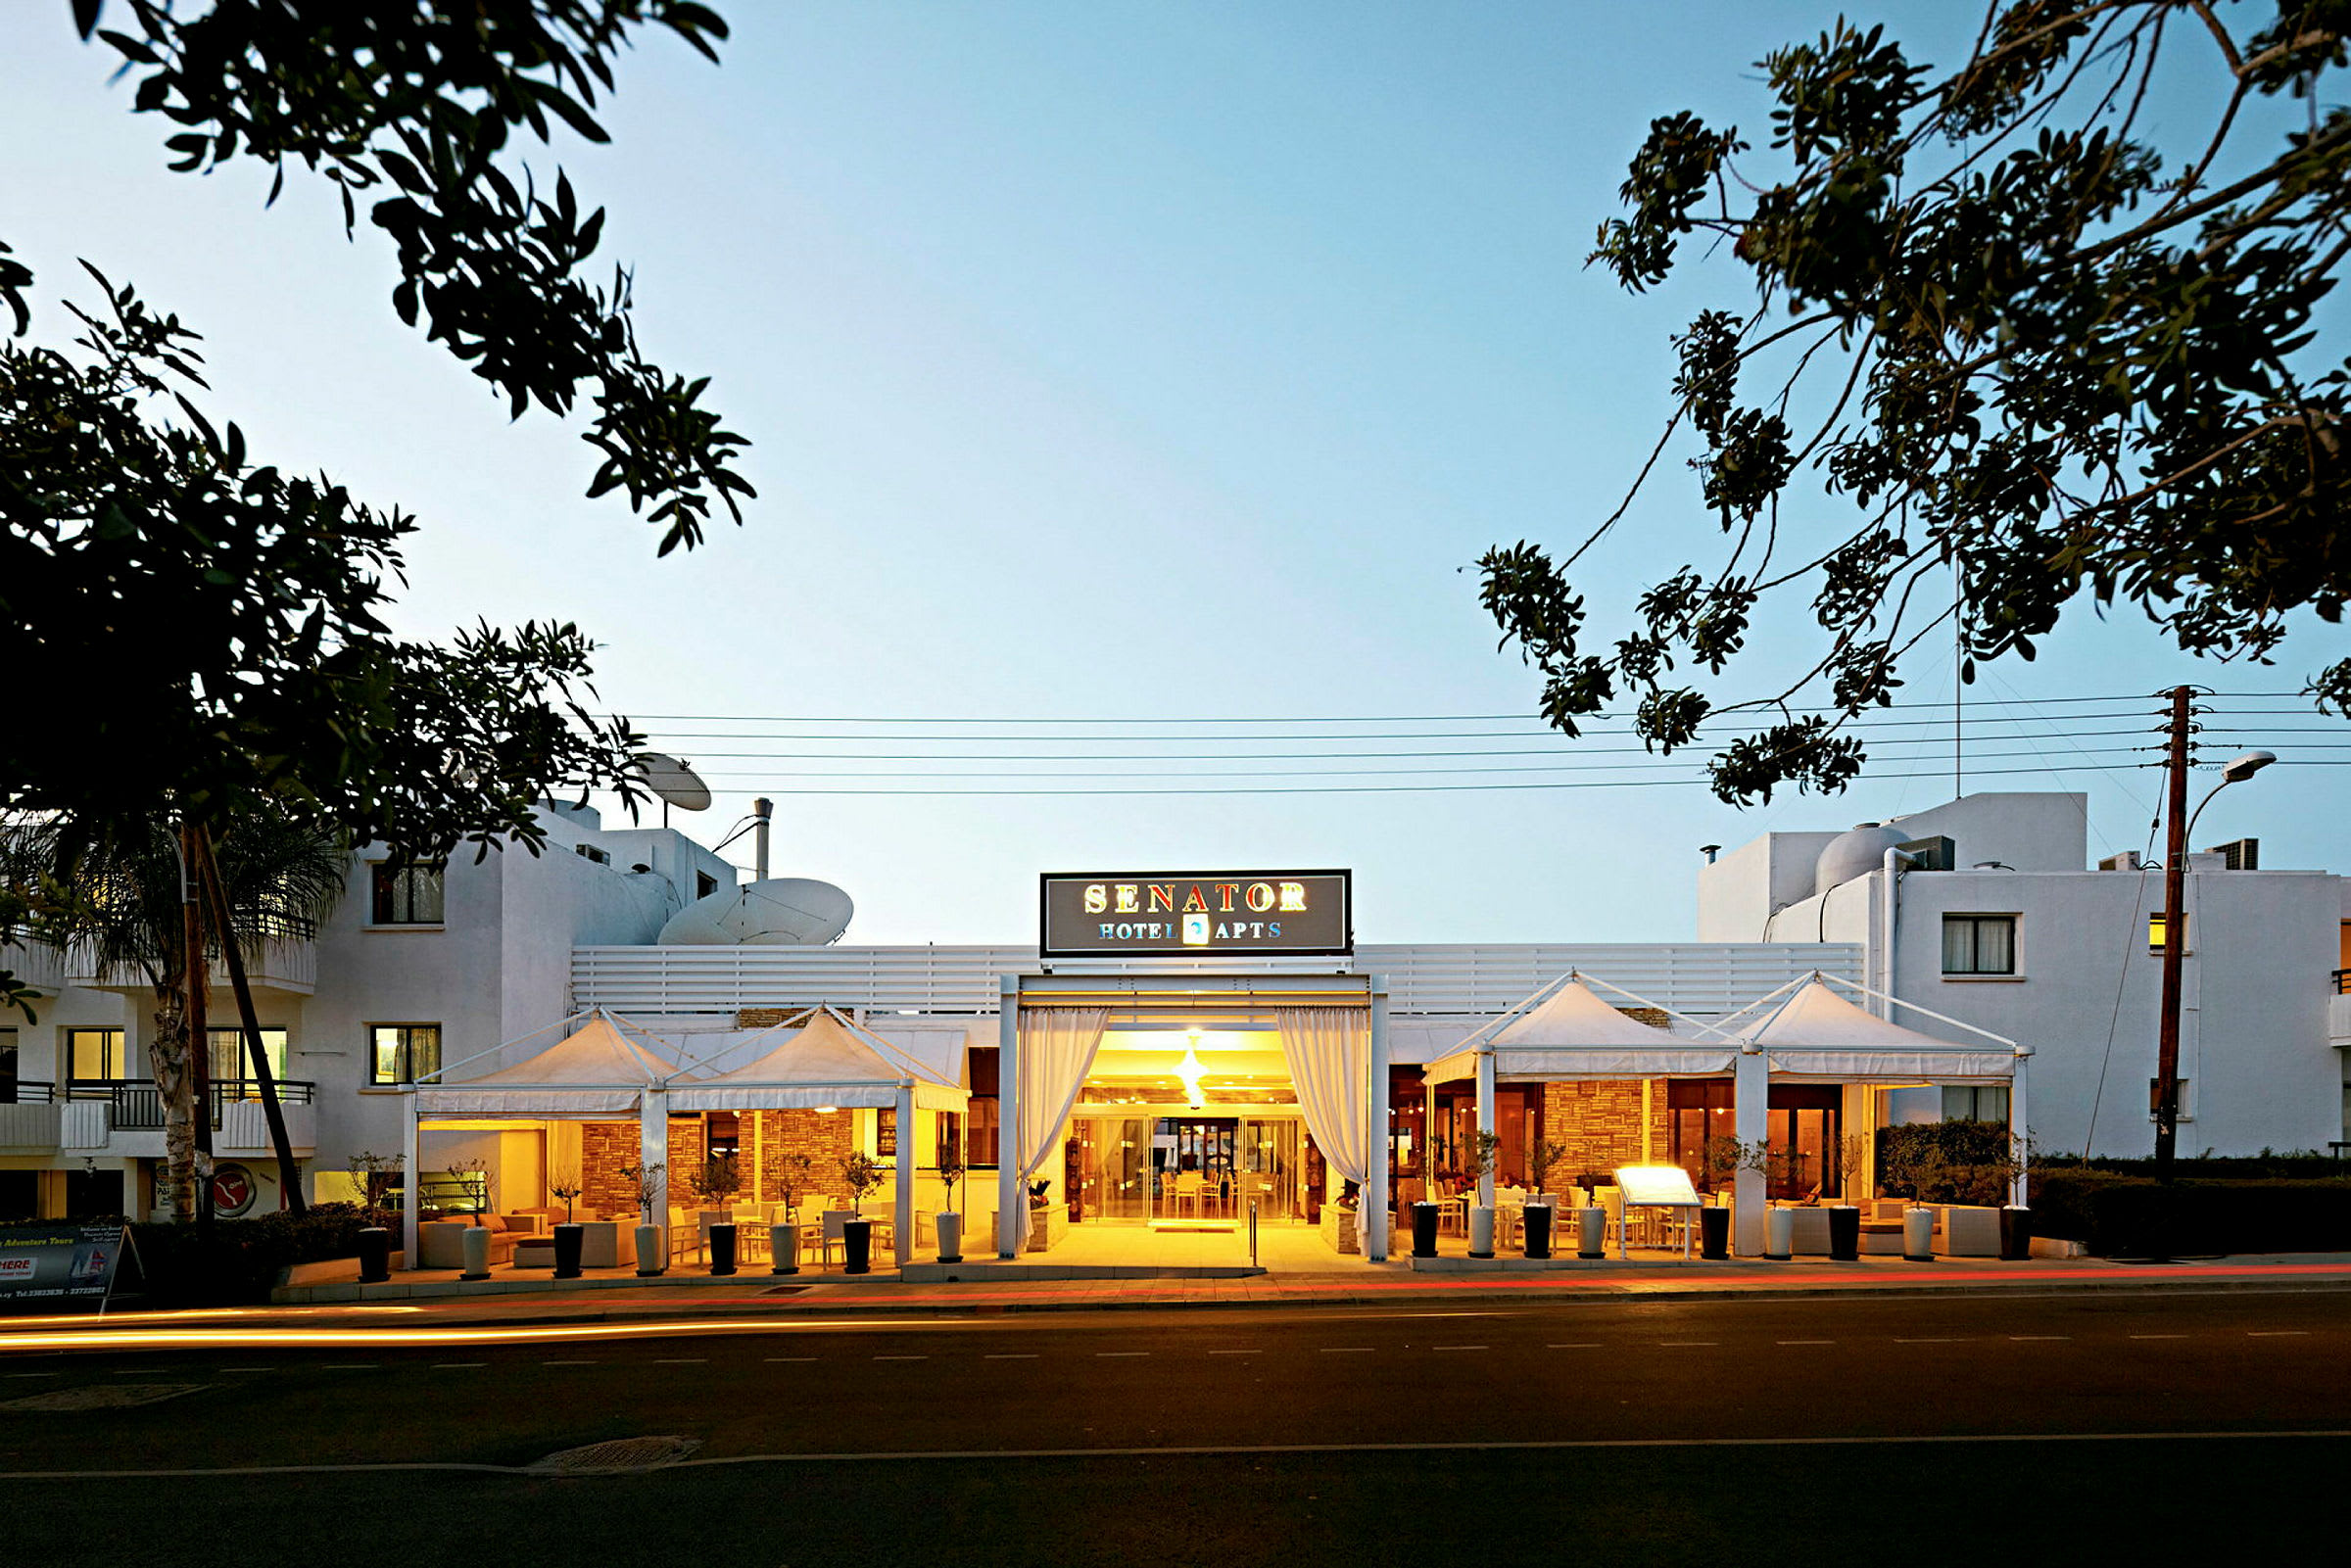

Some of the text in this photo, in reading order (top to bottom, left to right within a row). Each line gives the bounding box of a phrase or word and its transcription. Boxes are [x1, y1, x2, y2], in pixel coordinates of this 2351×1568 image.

[1084, 882, 1307, 913] SENATOR
[1099, 923, 1177, 939] HOTEL
[1215, 923, 1281, 939] APTS
[0, 1259, 30, 1269] HERE
